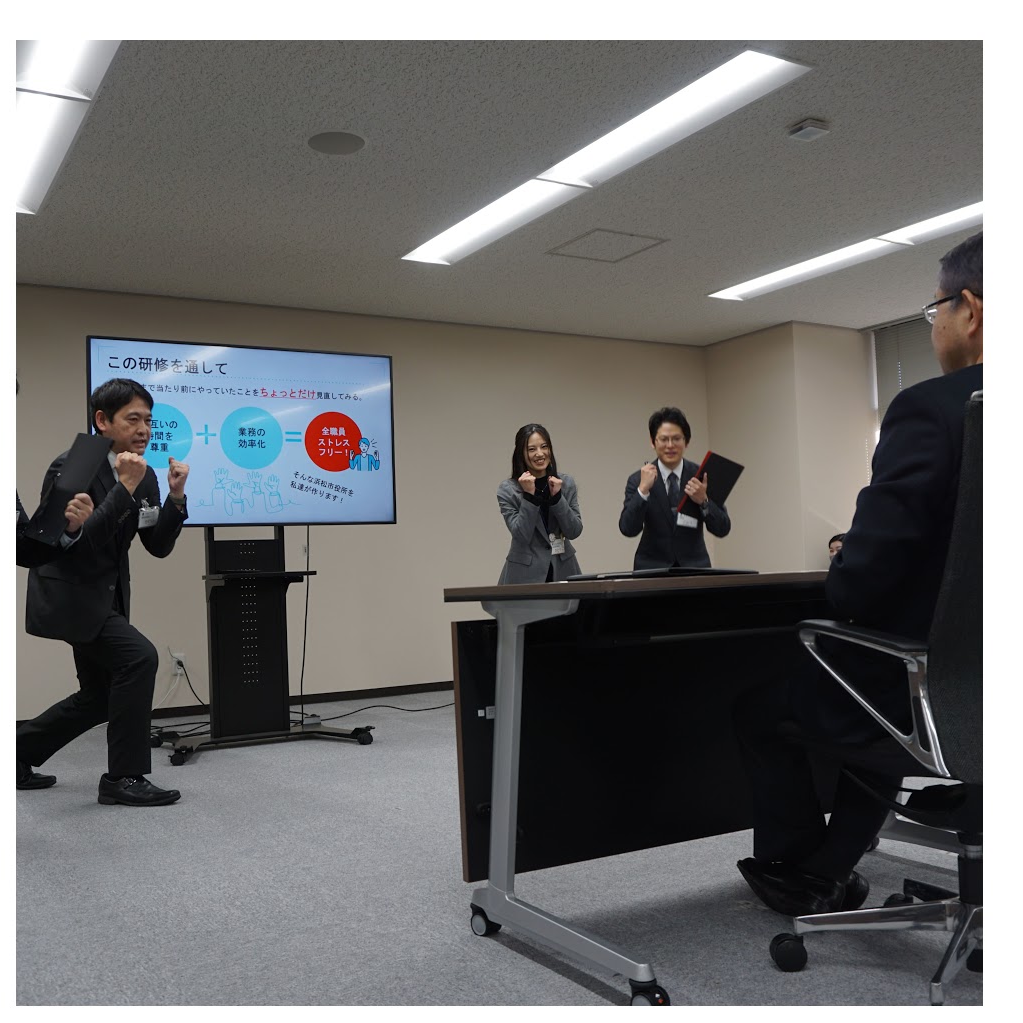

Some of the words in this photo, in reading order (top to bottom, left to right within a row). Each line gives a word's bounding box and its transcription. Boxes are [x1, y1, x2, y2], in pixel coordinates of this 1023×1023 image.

[108, 356, 228, 375] この研修を通して
[238, 427, 266, 437] 業務の
[321, 427, 346, 437] 全職員
[238, 439, 266, 449] 効率化
[318, 438, 351, 447] ストレス
[150, 443, 169, 453] 尊重
[318, 448, 349, 457] フリー！
[293, 471, 355, 498] そんな浜松市役所を
[290, 480, 344, 504] 私達が作ります！
